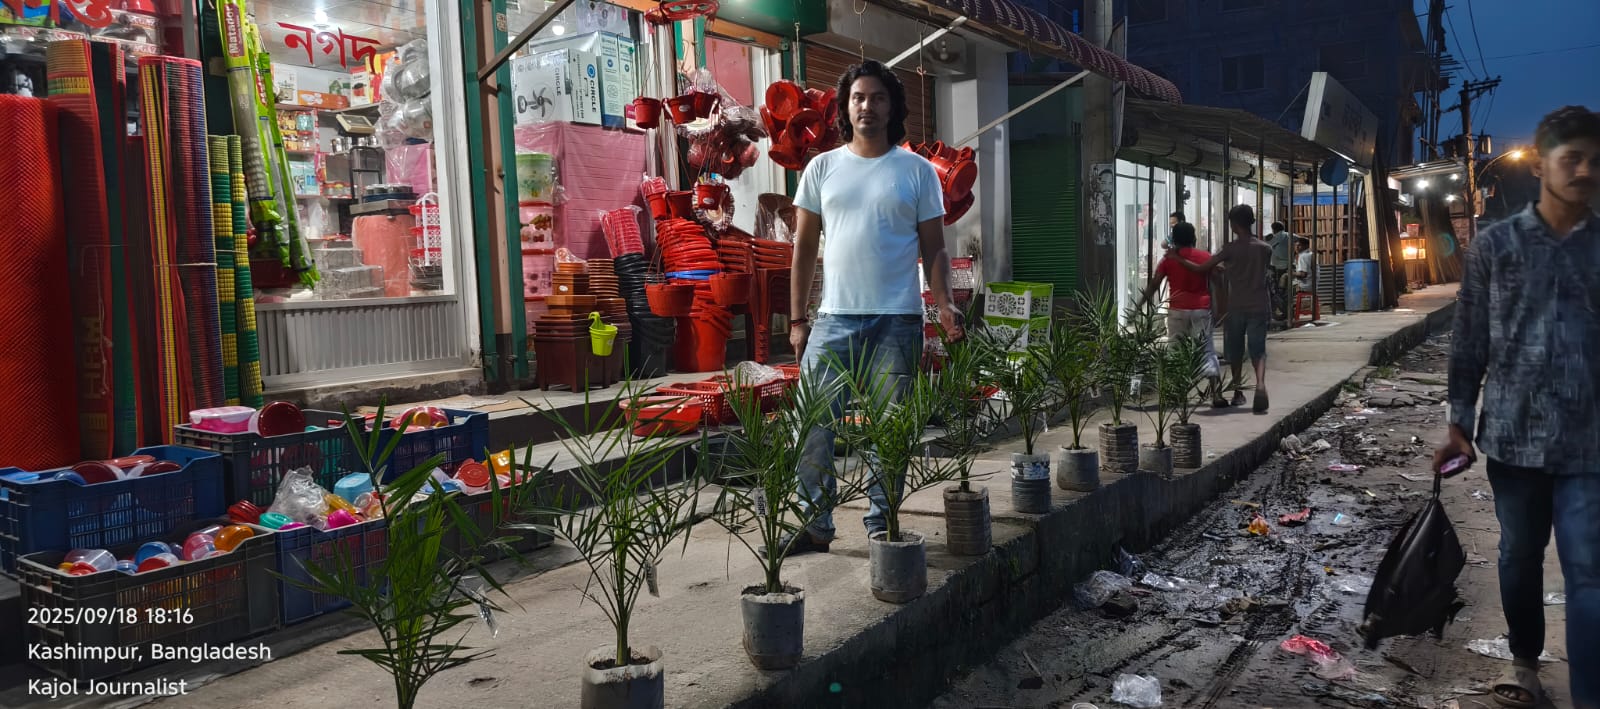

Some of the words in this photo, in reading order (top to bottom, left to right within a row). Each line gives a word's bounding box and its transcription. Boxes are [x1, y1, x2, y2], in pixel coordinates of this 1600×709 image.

[225, 4, 239, 54] Matador
[275, 21, 382, 75] নগদ
[589, 80, 597, 112] CIRCLE
